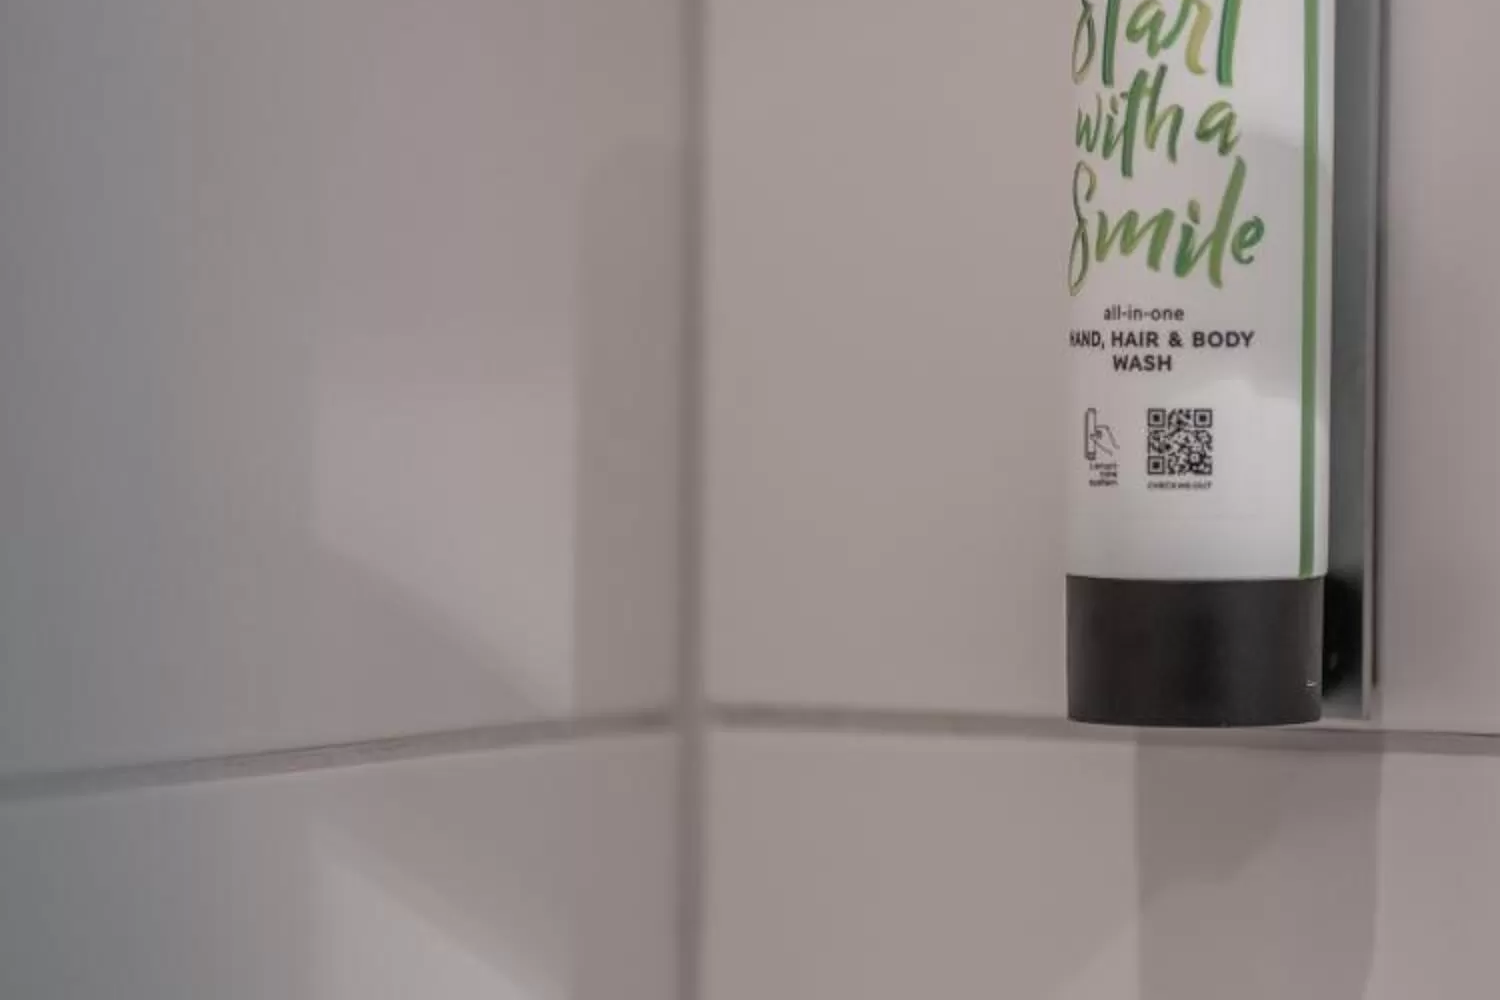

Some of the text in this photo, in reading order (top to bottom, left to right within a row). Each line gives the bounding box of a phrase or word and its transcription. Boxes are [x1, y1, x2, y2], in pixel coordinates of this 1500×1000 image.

[1075, 64, 1240, 179] with a
[1068, 155, 1265, 296] Smile
[1103, 304, 1185, 321] all-in-one
[1111, 331, 1159, 348] HAIR
[1168, 331, 1183, 348] &
[1192, 331, 1255, 348] BODY
[1113, 355, 1172, 372] WASH
